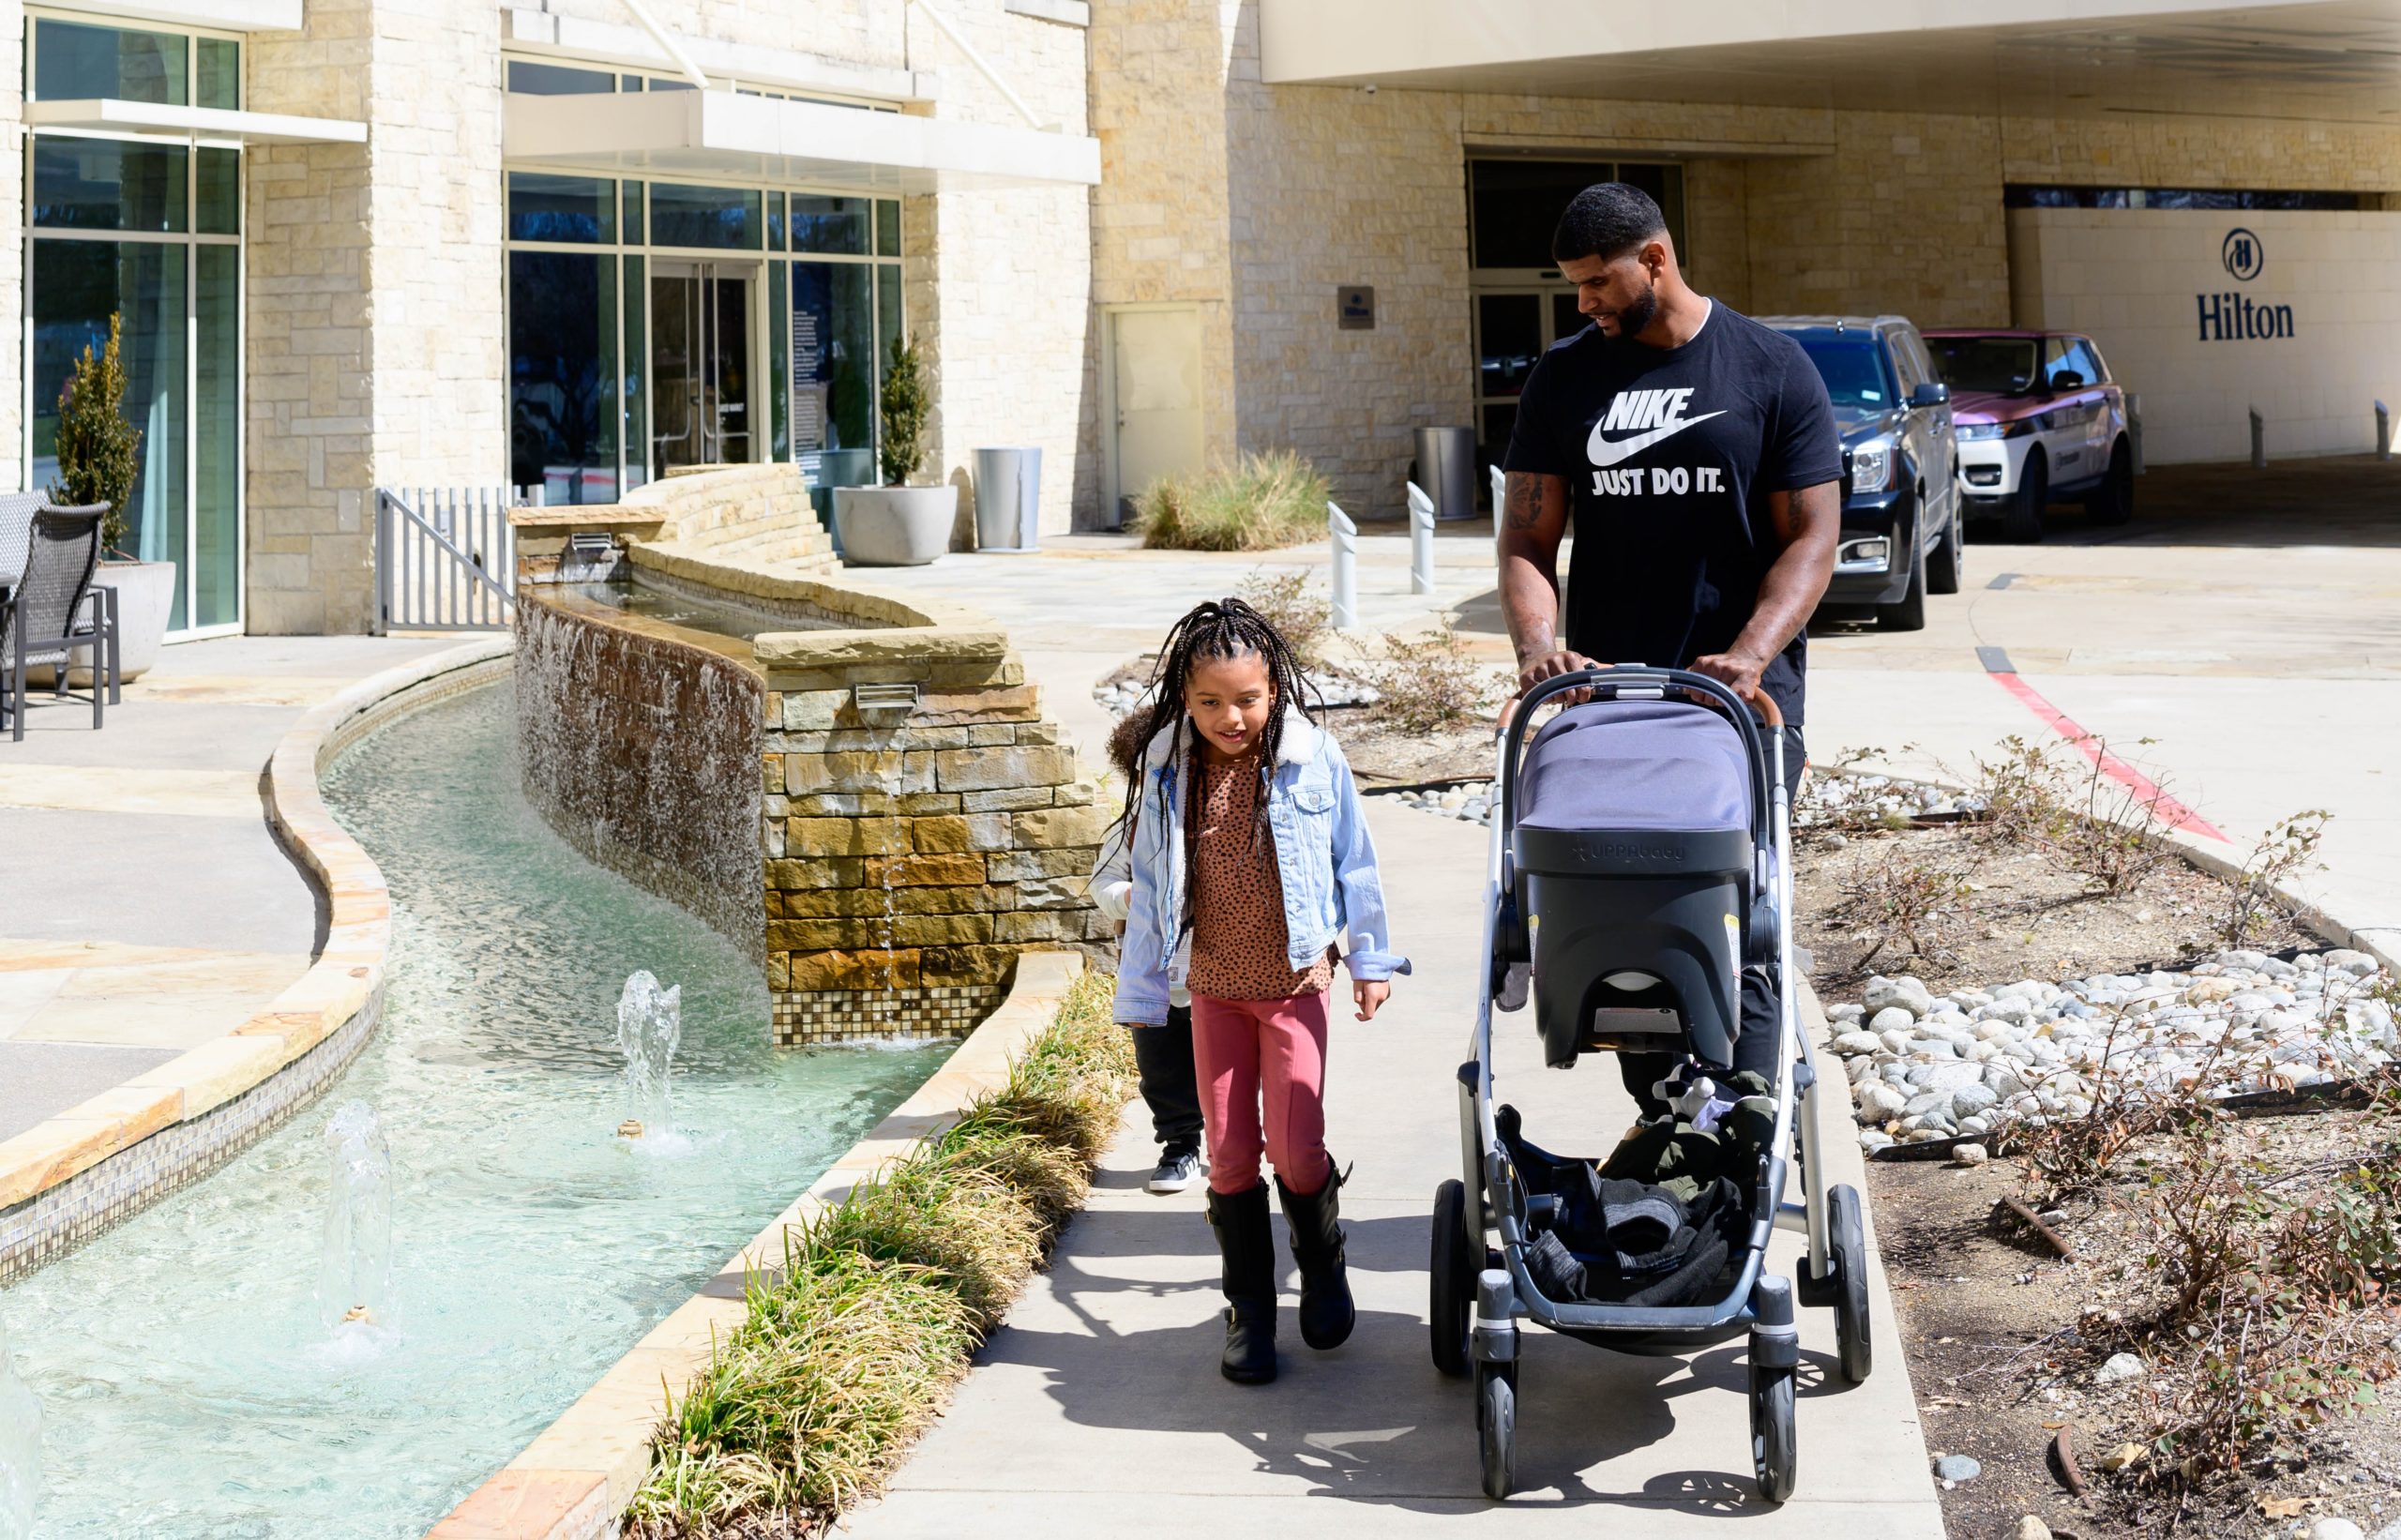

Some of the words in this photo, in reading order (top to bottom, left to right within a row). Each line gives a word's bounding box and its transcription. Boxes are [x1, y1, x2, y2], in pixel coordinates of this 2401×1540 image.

[2197, 292, 2295, 341] Hilton
[1602, 387, 1695, 431] NIKE
[1592, 468, 1645, 497] JUST
[1651, 466, 1690, 495] DO
[1696, 466, 1726, 493] IT.
